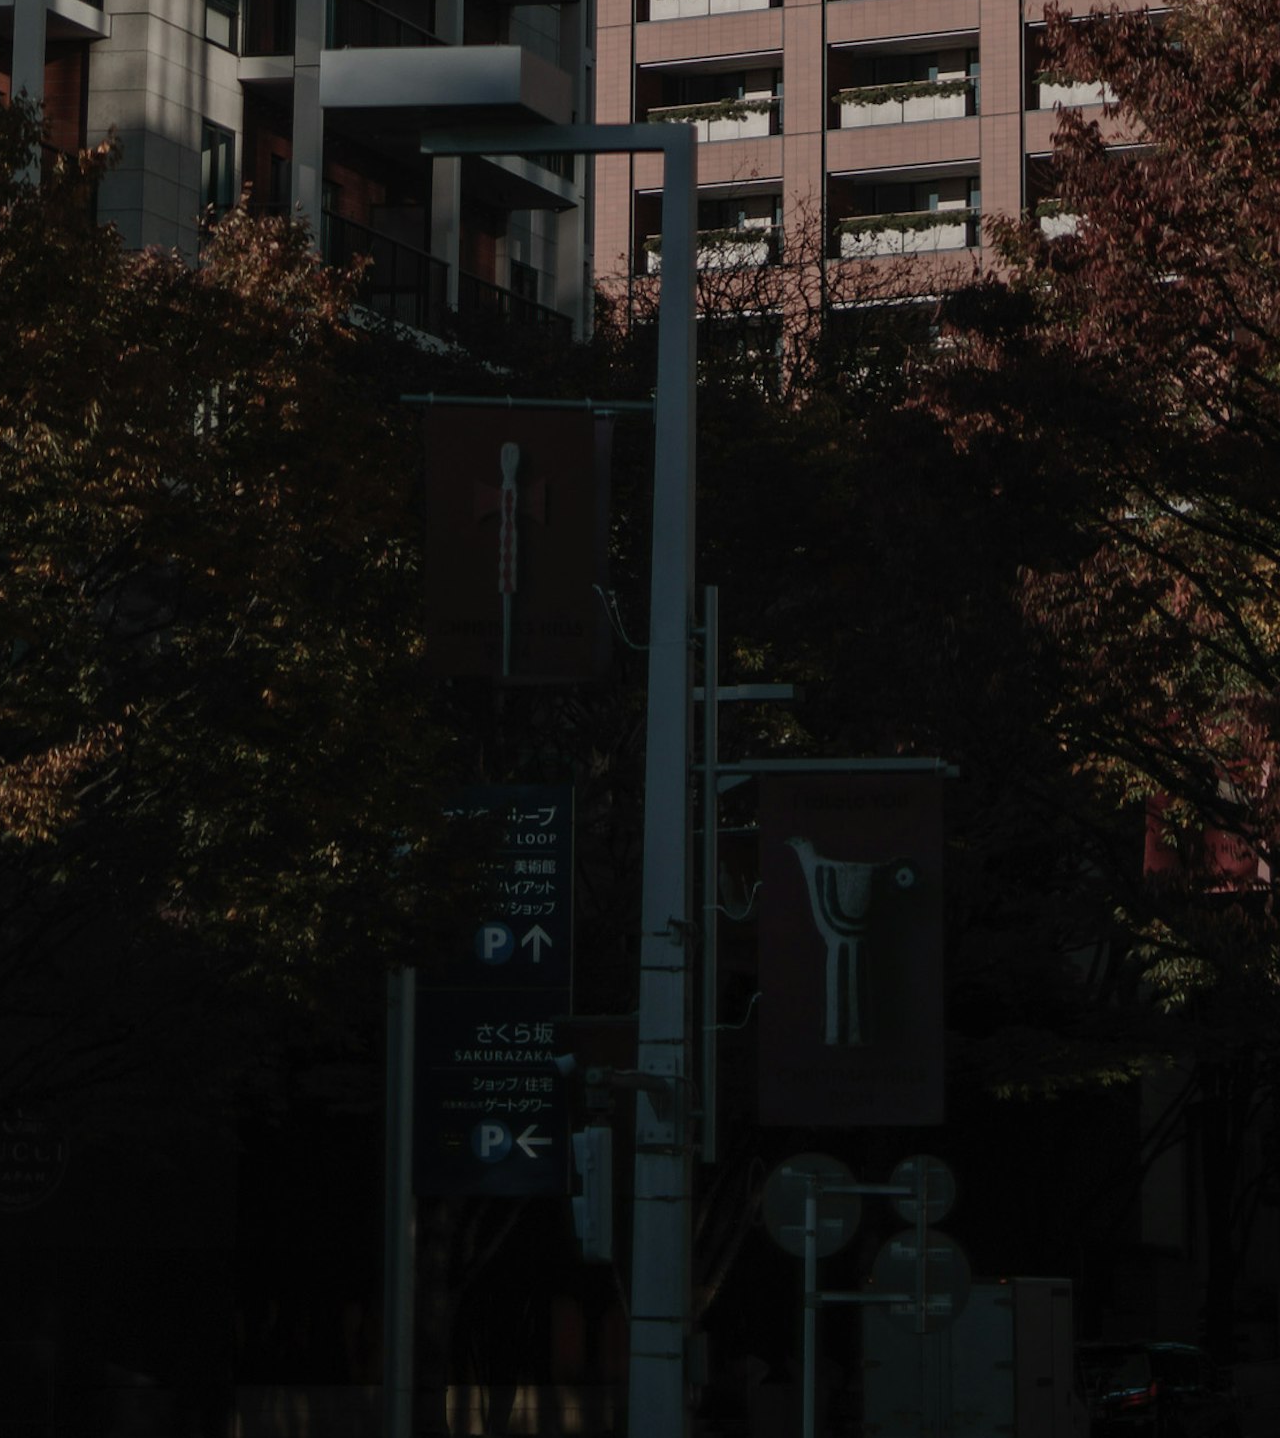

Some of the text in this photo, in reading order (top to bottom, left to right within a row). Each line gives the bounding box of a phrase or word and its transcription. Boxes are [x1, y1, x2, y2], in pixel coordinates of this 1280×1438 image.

[516, 833, 558, 845] LOOP
[475, 1023, 555, 1044] さくら坂
[454, 1049, 554, 1063] SAKURAZAKA
